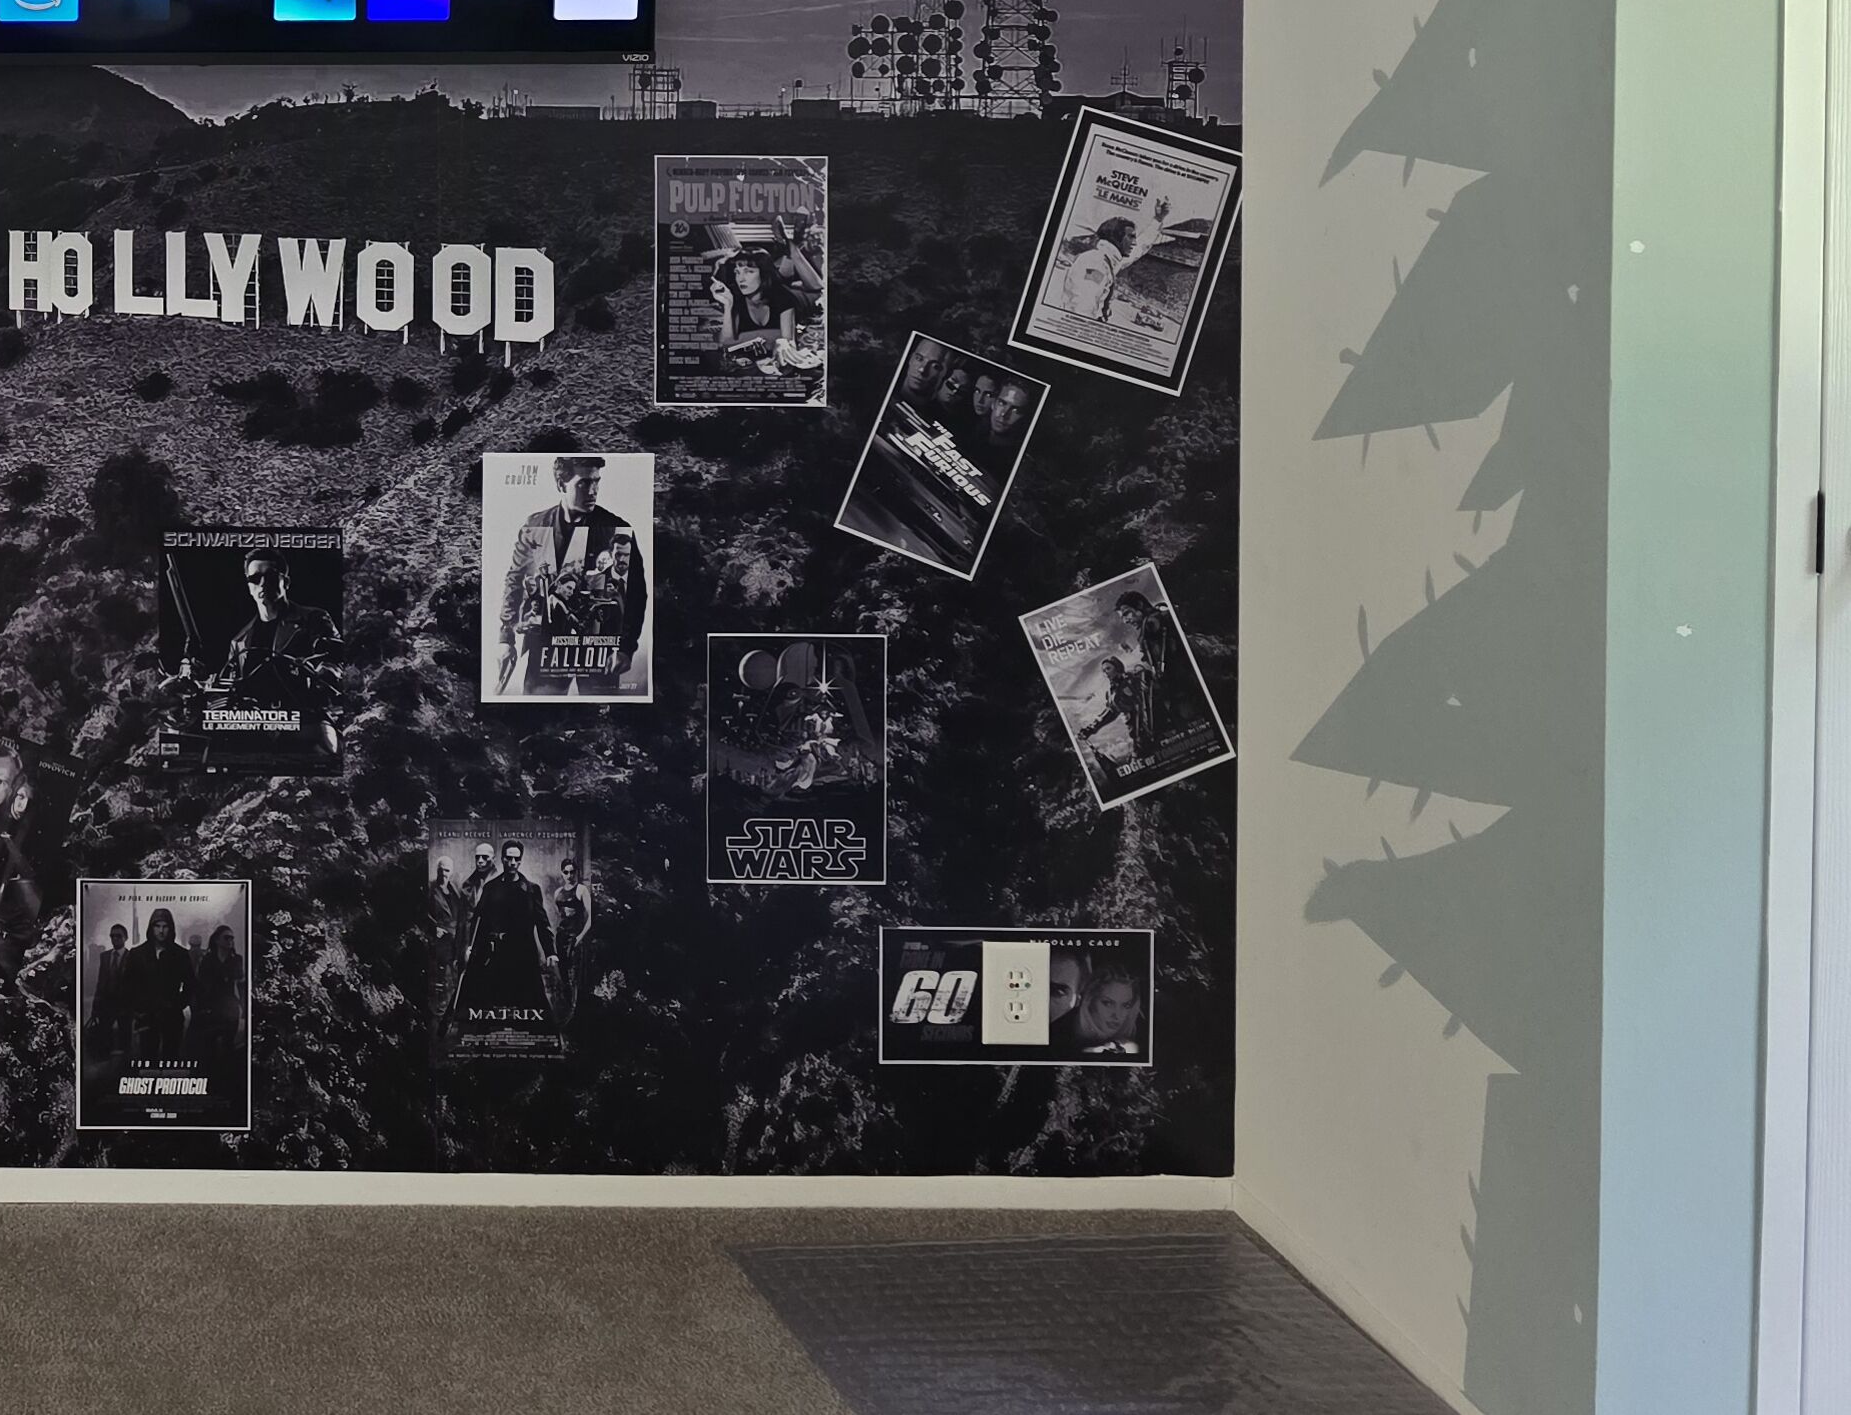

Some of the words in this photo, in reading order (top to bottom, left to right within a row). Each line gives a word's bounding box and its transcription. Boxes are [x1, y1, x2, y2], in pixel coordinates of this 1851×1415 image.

[622, 53, 650, 62] VIZIO
[1096, 175, 1148, 197] McQUEEN
[1111, 170, 1139, 185] STEVE
[669, 180, 726, 213] PULP
[729, 180, 816, 213] FICTION
[8, 229, 555, 343] HOLLYWOOD
[932, 434, 983, 477] FAST
[521, 465, 538, 474] TOM
[904, 432, 991, 506] FURIOUS
[505, 475, 537, 485] CRUISE
[163, 532, 341, 549] SCHWARZENEGGER
[1042, 631, 1067, 650] DIE
[1048, 632, 1100, 664] REPEAT
[540, 647, 619, 667] FALLOUT
[202, 710, 288, 721] TERMINATOR
[291, 711, 300, 721] 2
[1116, 759, 1145, 777] EDGE
[726, 818, 866, 849] STAR
[726, 848, 866, 880] WARS
[1089, 939, 1120, 947] CAGE
[889, 970, 978, 1024] 60
[468, 1008, 545, 1020] MATRIX
[119, 1077, 155, 1094] GHOST
[155, 1078, 208, 1095] PROTOCOL
